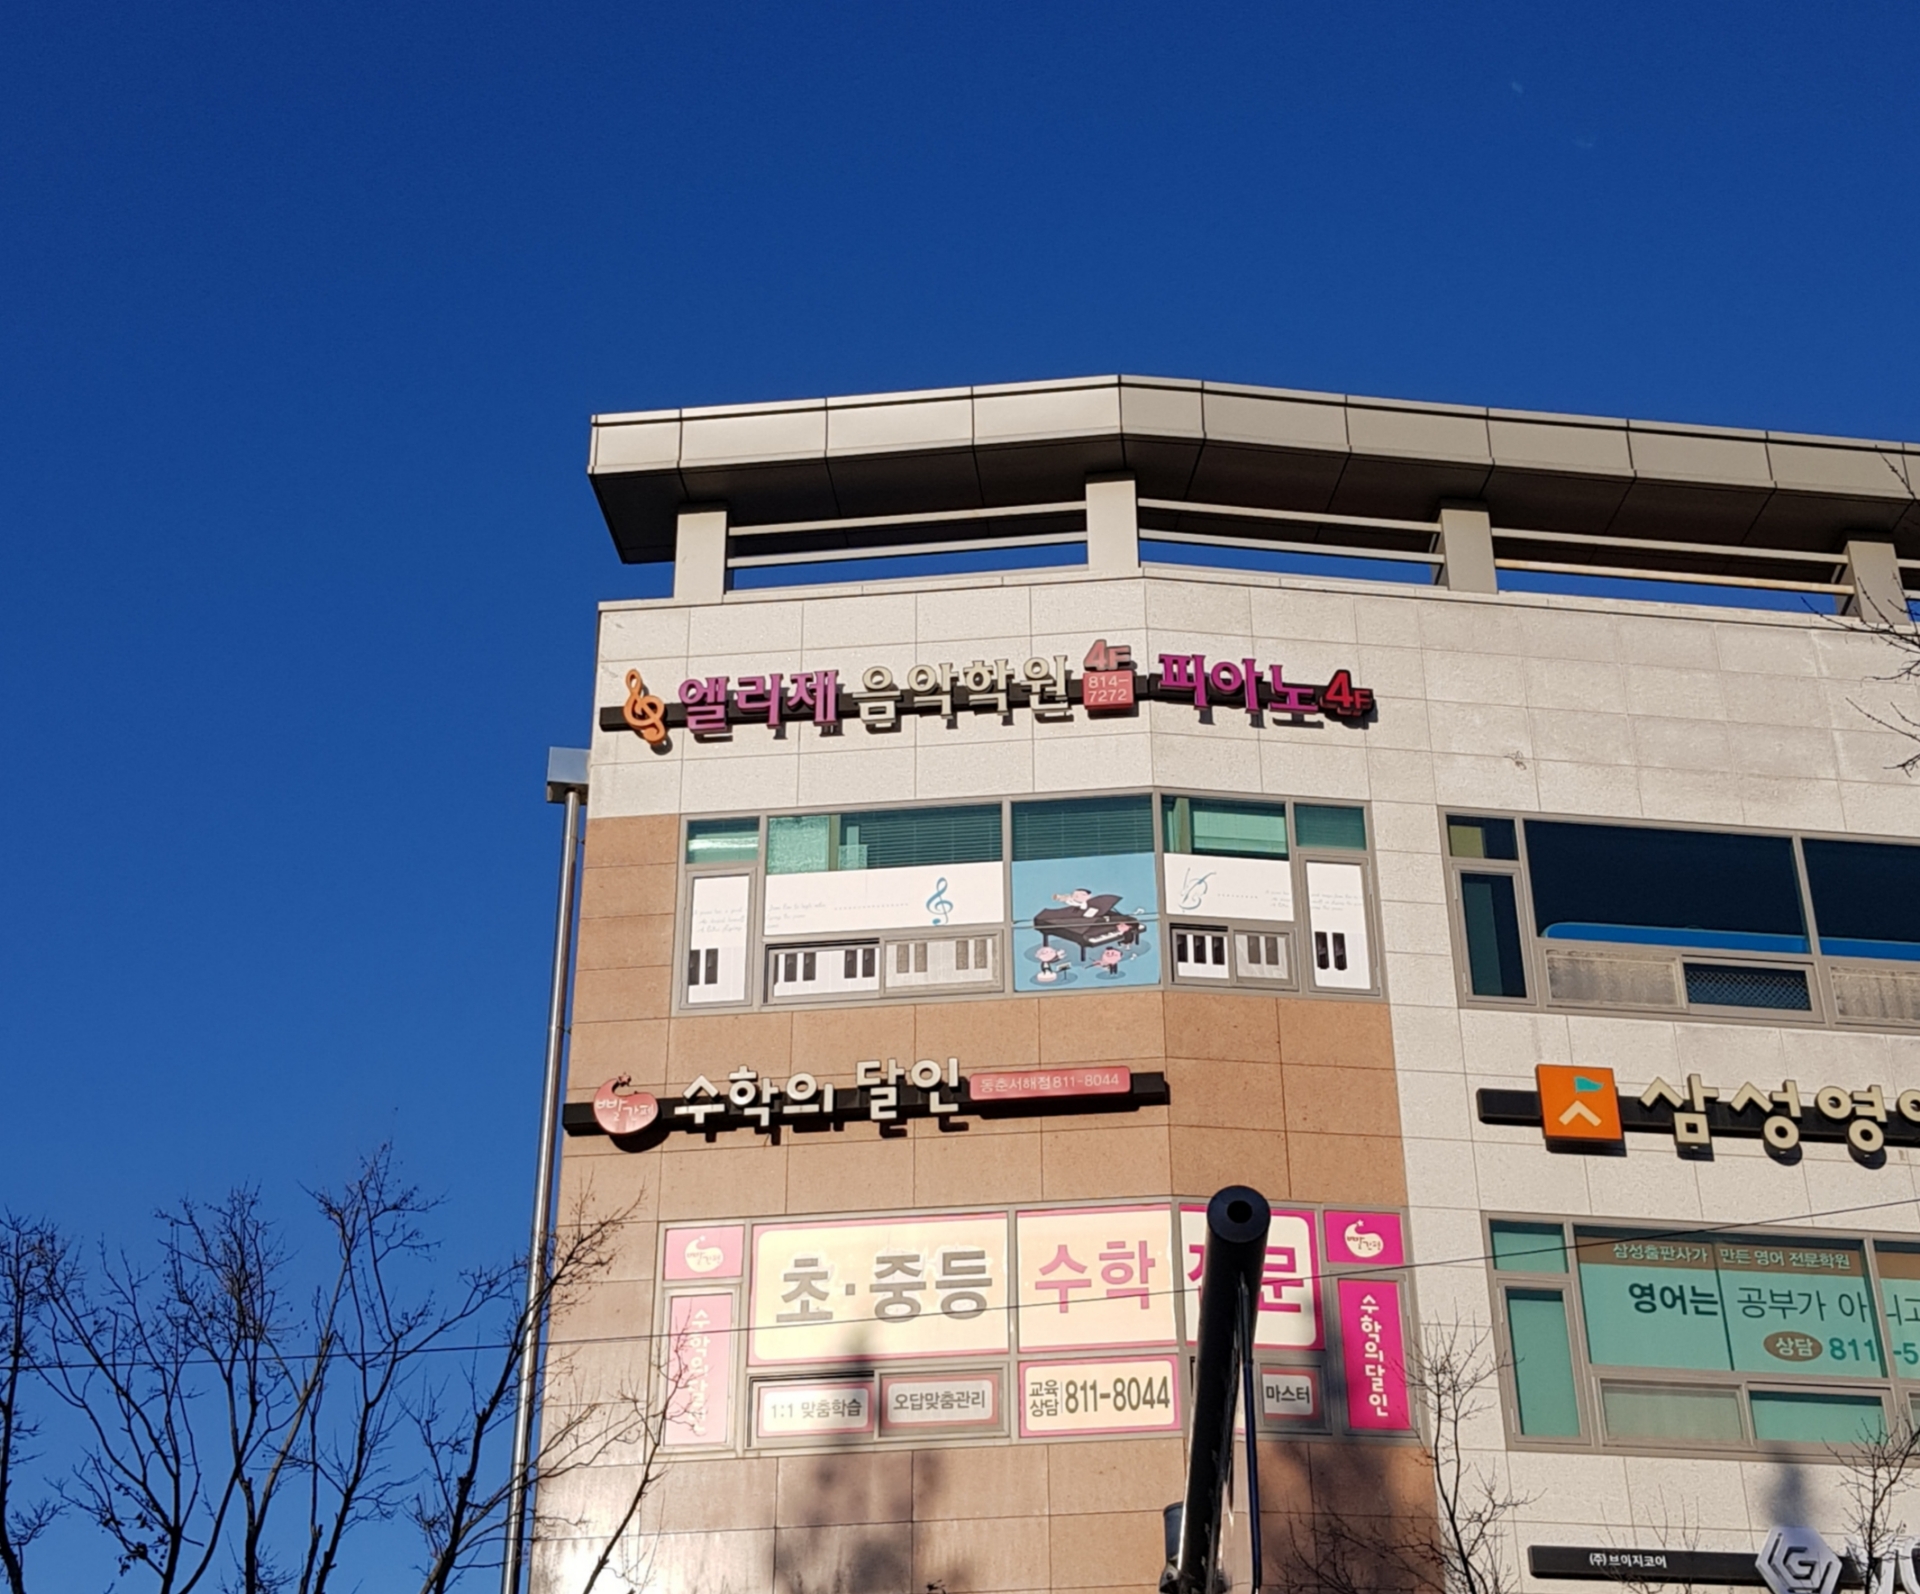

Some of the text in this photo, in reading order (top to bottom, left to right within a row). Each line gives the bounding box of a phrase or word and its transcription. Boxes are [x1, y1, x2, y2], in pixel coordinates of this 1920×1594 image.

[1083, 639, 1131, 670] 4F
[678, 655, 1068, 733] 엘리제 음악학원
[1088, 689, 1128, 702] 7272
[1158, 654, 1372, 714] 피아노 4F
[674, 1057, 959, 1126] 수학의 달인
[1052, 1073, 1120, 1089] 811-8044
[1613, 1243, 1851, 1270] 삼성출판사가 만든 영어 전문학원
[1034, 1240, 1156, 1314] 수학
[1628, 1283, 1719, 1316] 영어는
[1737, 1286, 1827, 1322] 공부가
[1776, 1337, 1813, 1356] 상담
[893, 1390, 986, 1411] 오답맞춤관리
[1029, 1379, 1059, 1397] 교육
[1065, 1376, 1171, 1414] 811-8044
[770, 1399, 863, 1419] 1:1 맞춤학습
[1029, 1399, 1059, 1417] 상담
